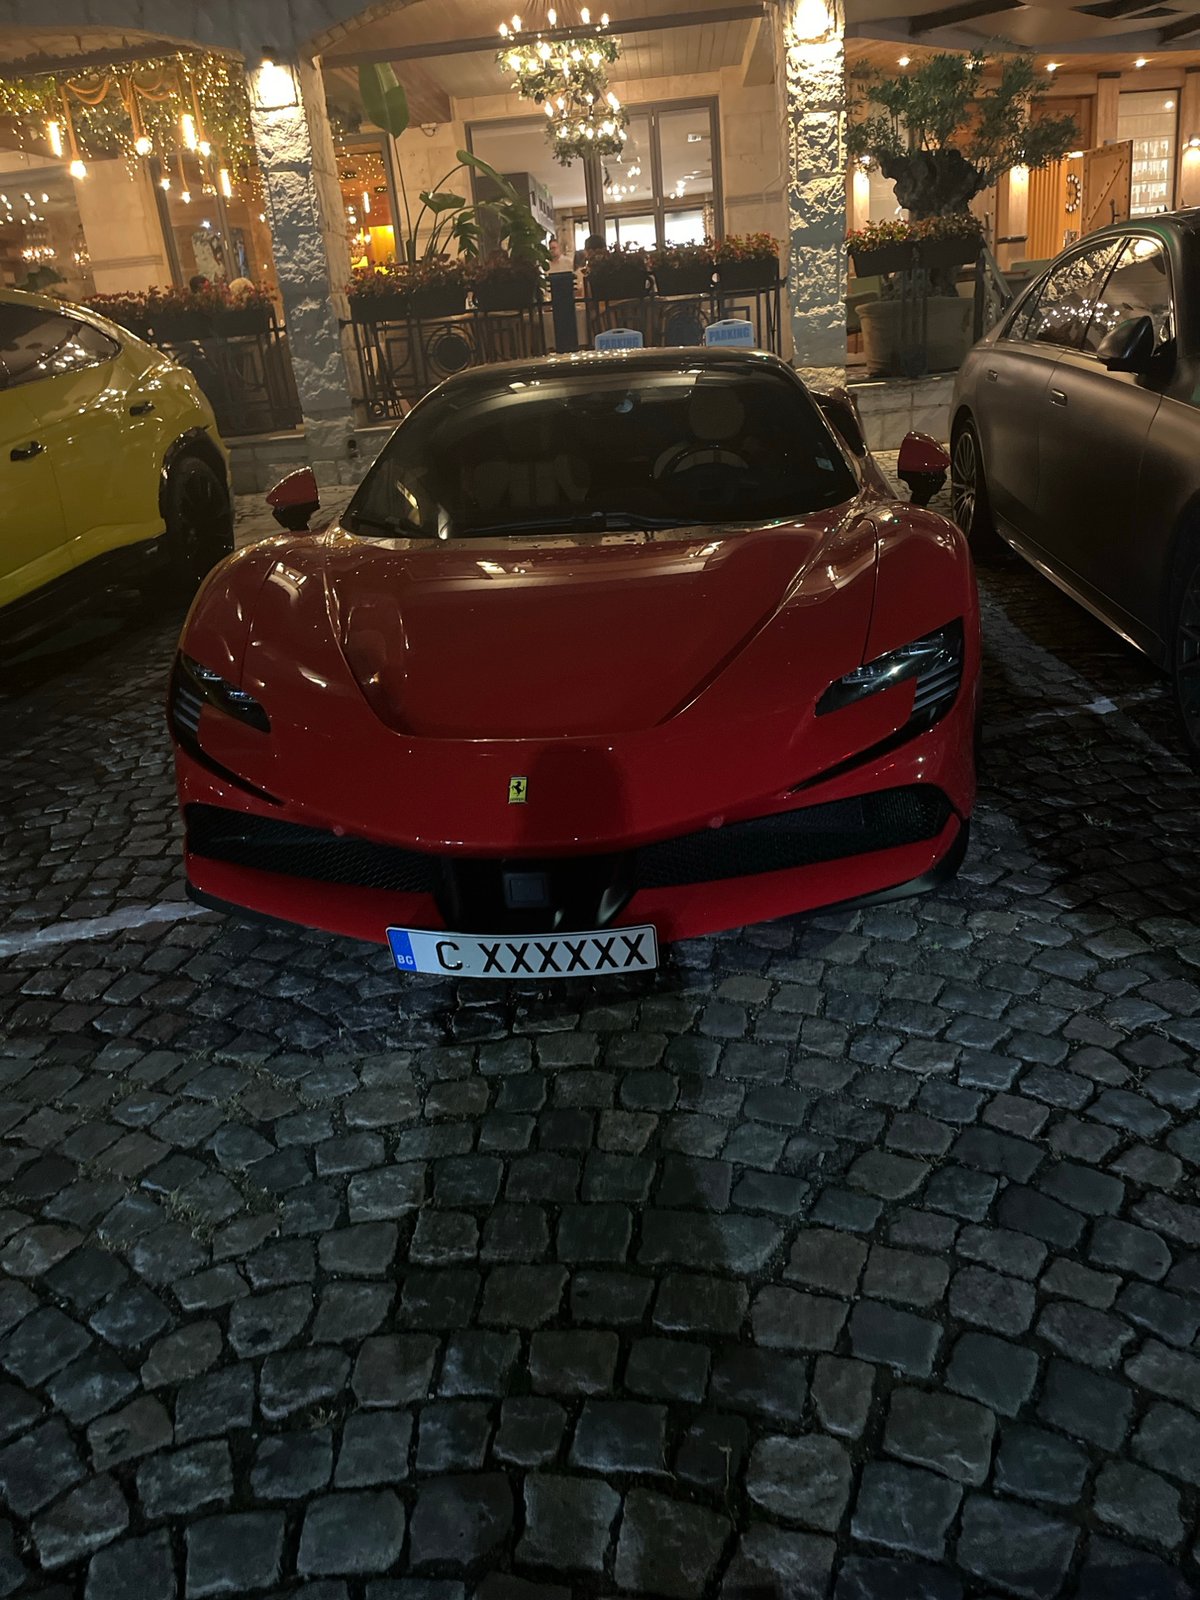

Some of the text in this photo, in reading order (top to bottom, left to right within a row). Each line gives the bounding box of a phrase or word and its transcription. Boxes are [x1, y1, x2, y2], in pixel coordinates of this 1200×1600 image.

[708, 326, 750, 342] PARKING
[397, 954, 414, 965] BG
[436, 933, 648, 974] C XXXXXX
